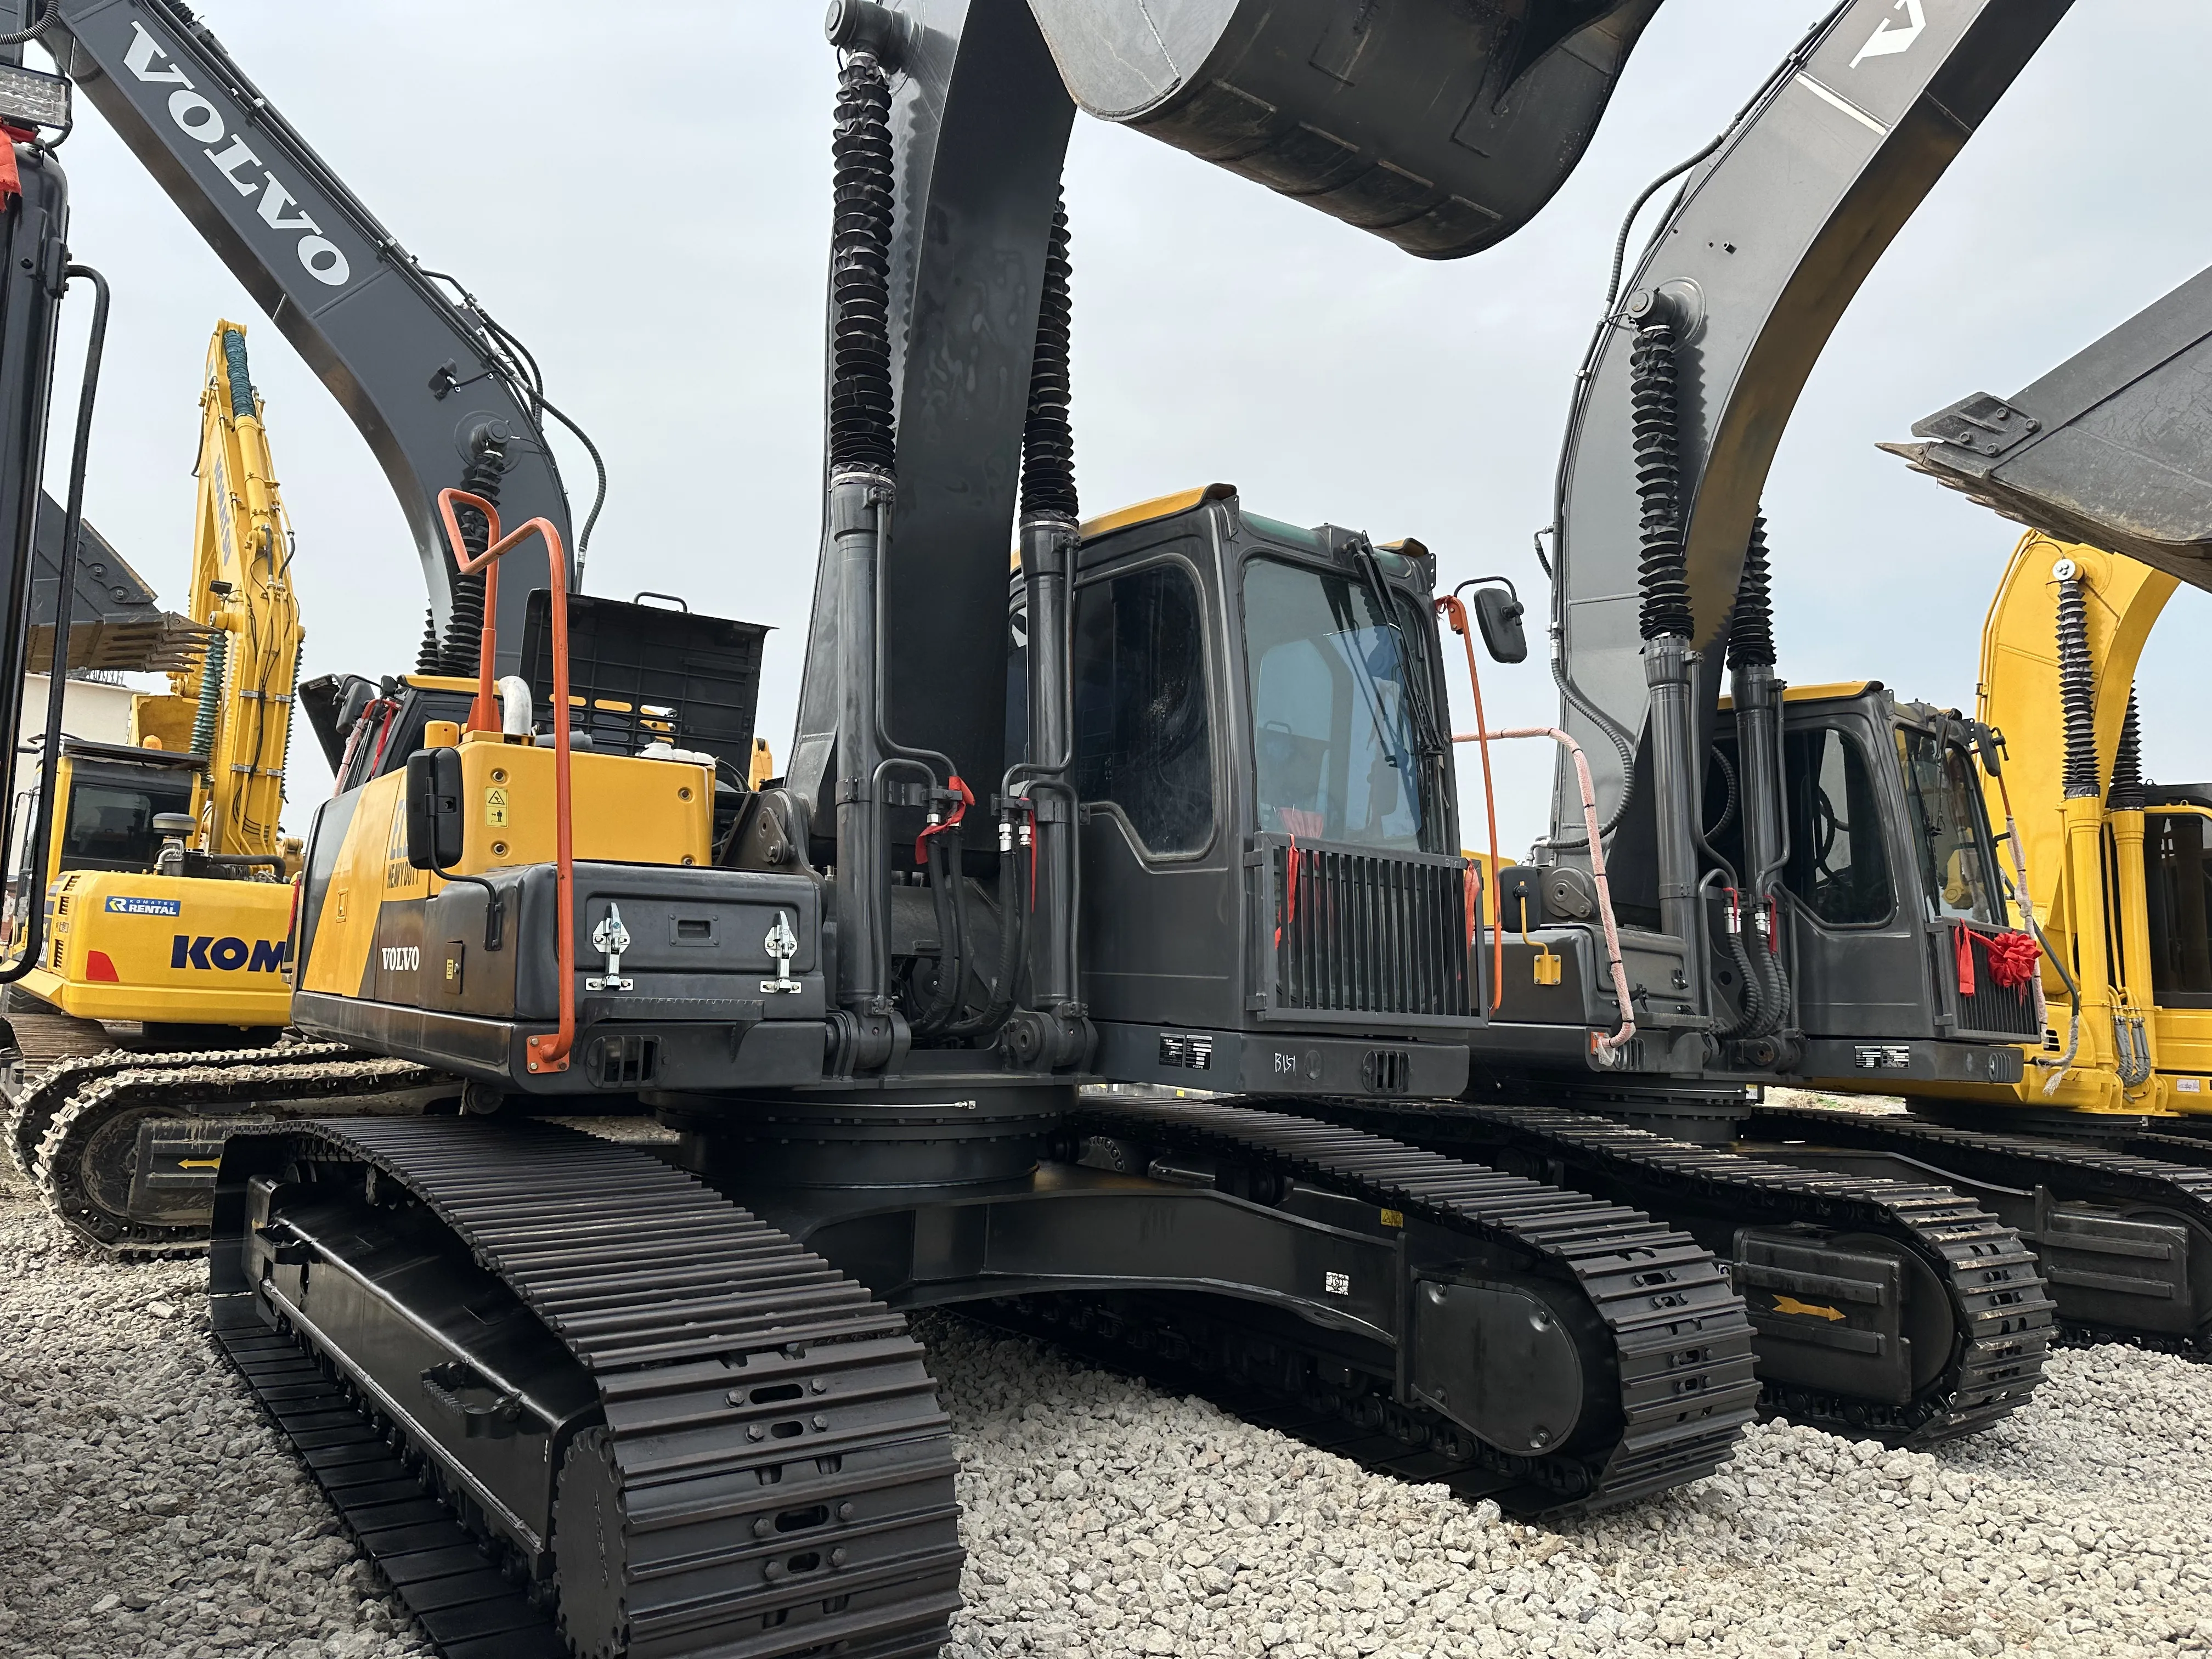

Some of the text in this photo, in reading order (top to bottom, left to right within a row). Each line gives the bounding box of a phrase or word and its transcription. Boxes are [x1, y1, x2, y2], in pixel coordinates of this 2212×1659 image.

[123, 20, 350, 286] VOLVO
[214, 452, 231, 567] KOMATSU
[387, 862, 404, 889] HEAVY
[128, 904, 177, 915] RENTAL
[381, 946, 420, 971] VOLVO
